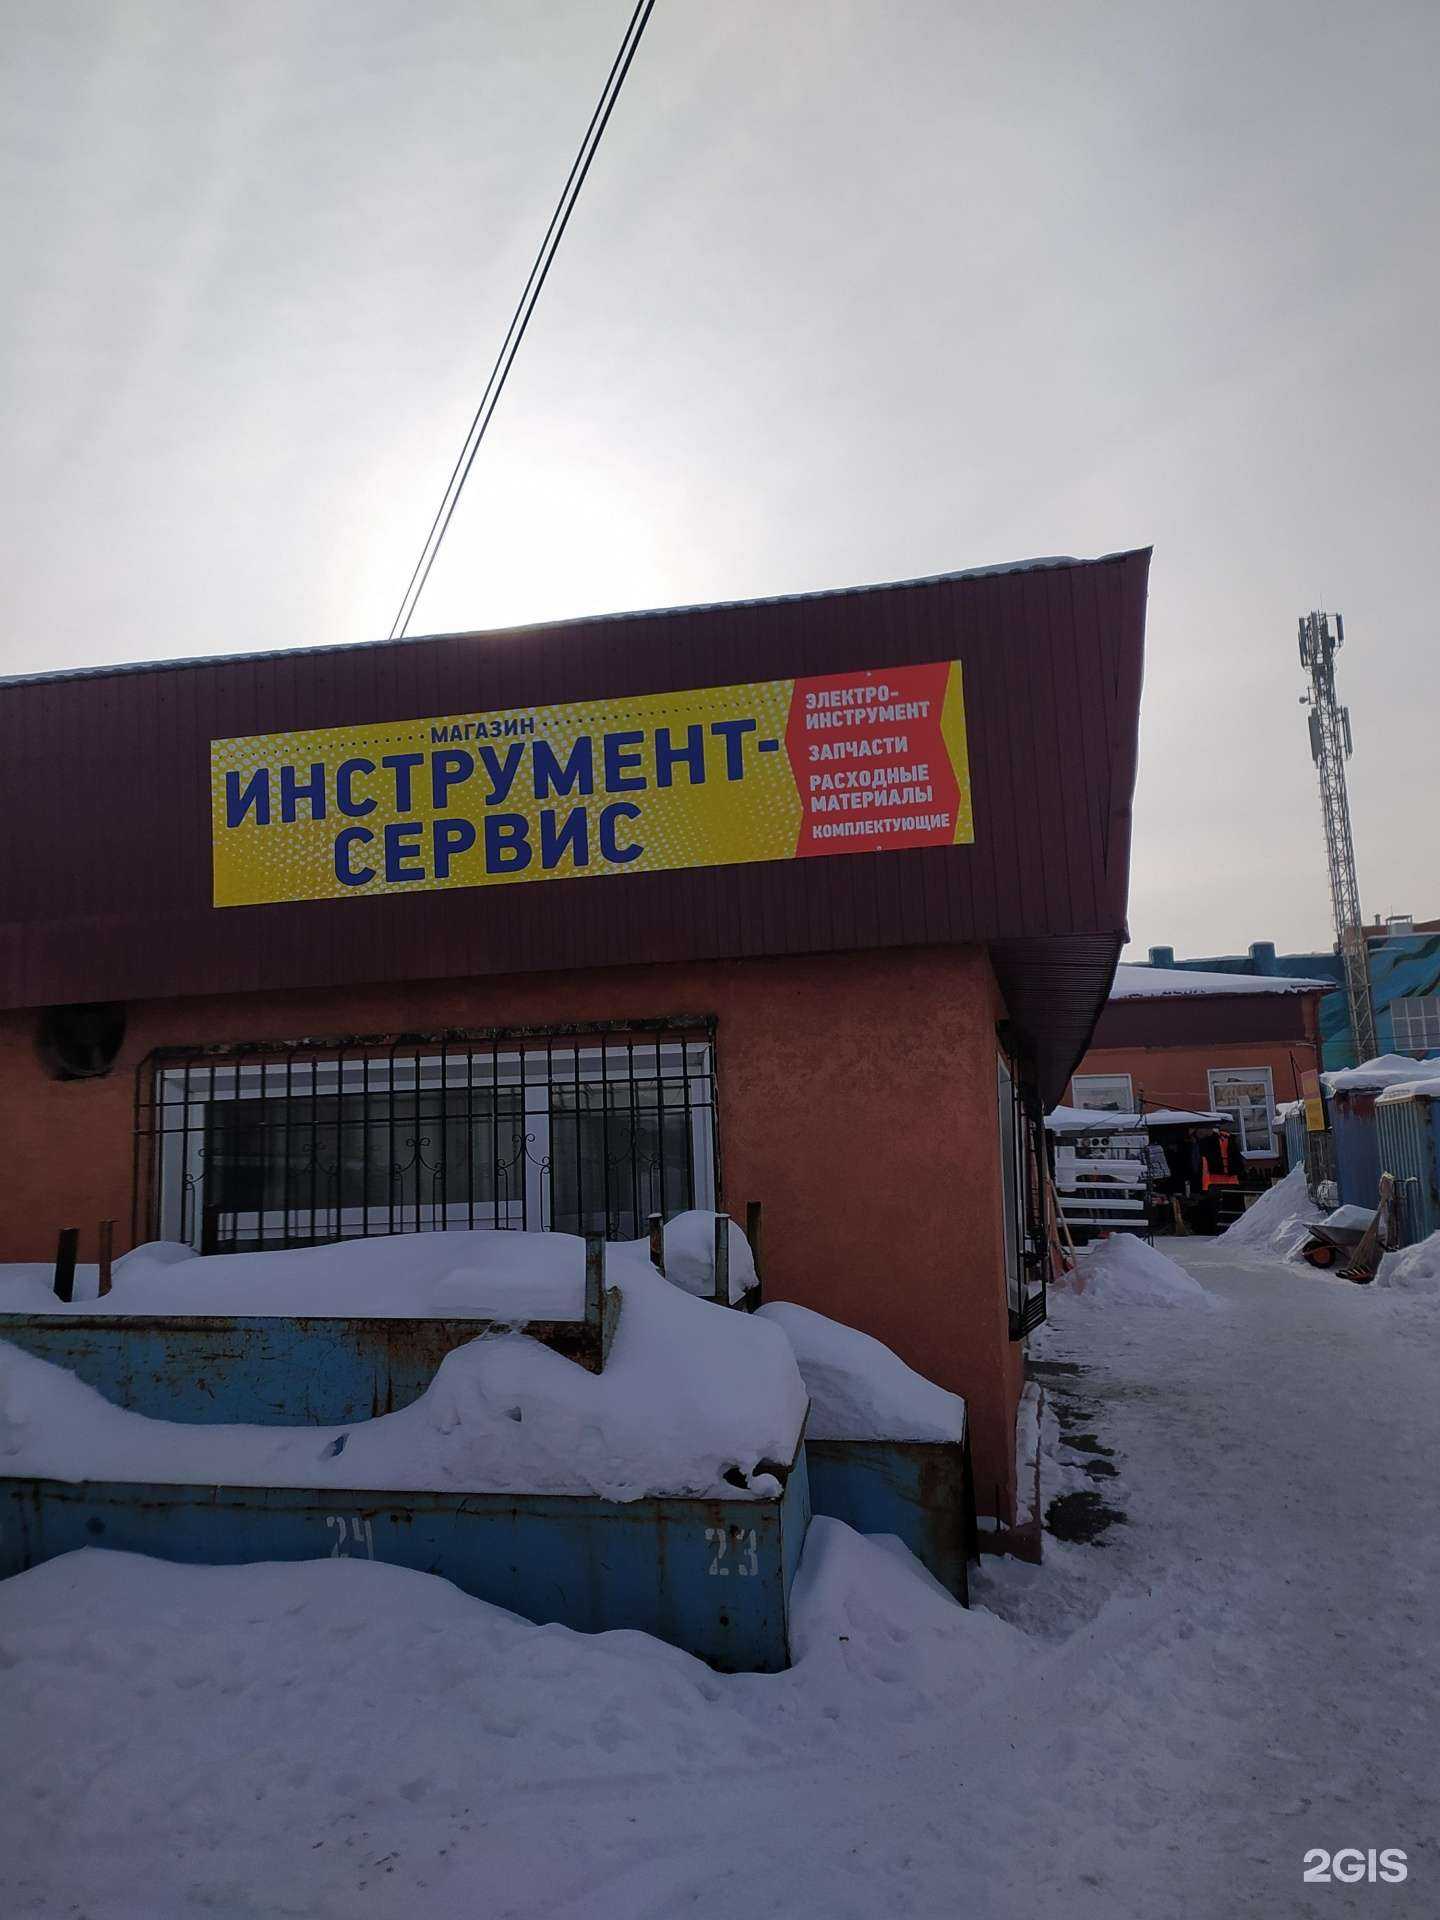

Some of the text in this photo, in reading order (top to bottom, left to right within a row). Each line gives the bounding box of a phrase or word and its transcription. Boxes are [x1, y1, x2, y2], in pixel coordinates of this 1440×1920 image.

[805, 685, 899, 709] ЭЛЕКТРО-
[805, 700, 930, 730] ИНСТРУМЕНТ
[431, 717, 535, 744] МАГАЗИН
[808, 735, 908, 762] ЗАПЧАСТИ
[225, 719, 779, 828] ИНСТРУМЕНТ-
[809, 763, 929, 792] РАСХОДНЫЕ
[810, 785, 933, 813] МАТЕРИАЛЫ
[812, 813, 950, 839] КОМПЛЕКТУЮЩИЕ
[333, 802, 644, 886] СЕРВИС
[705, 1527, 759, 1577] 23
